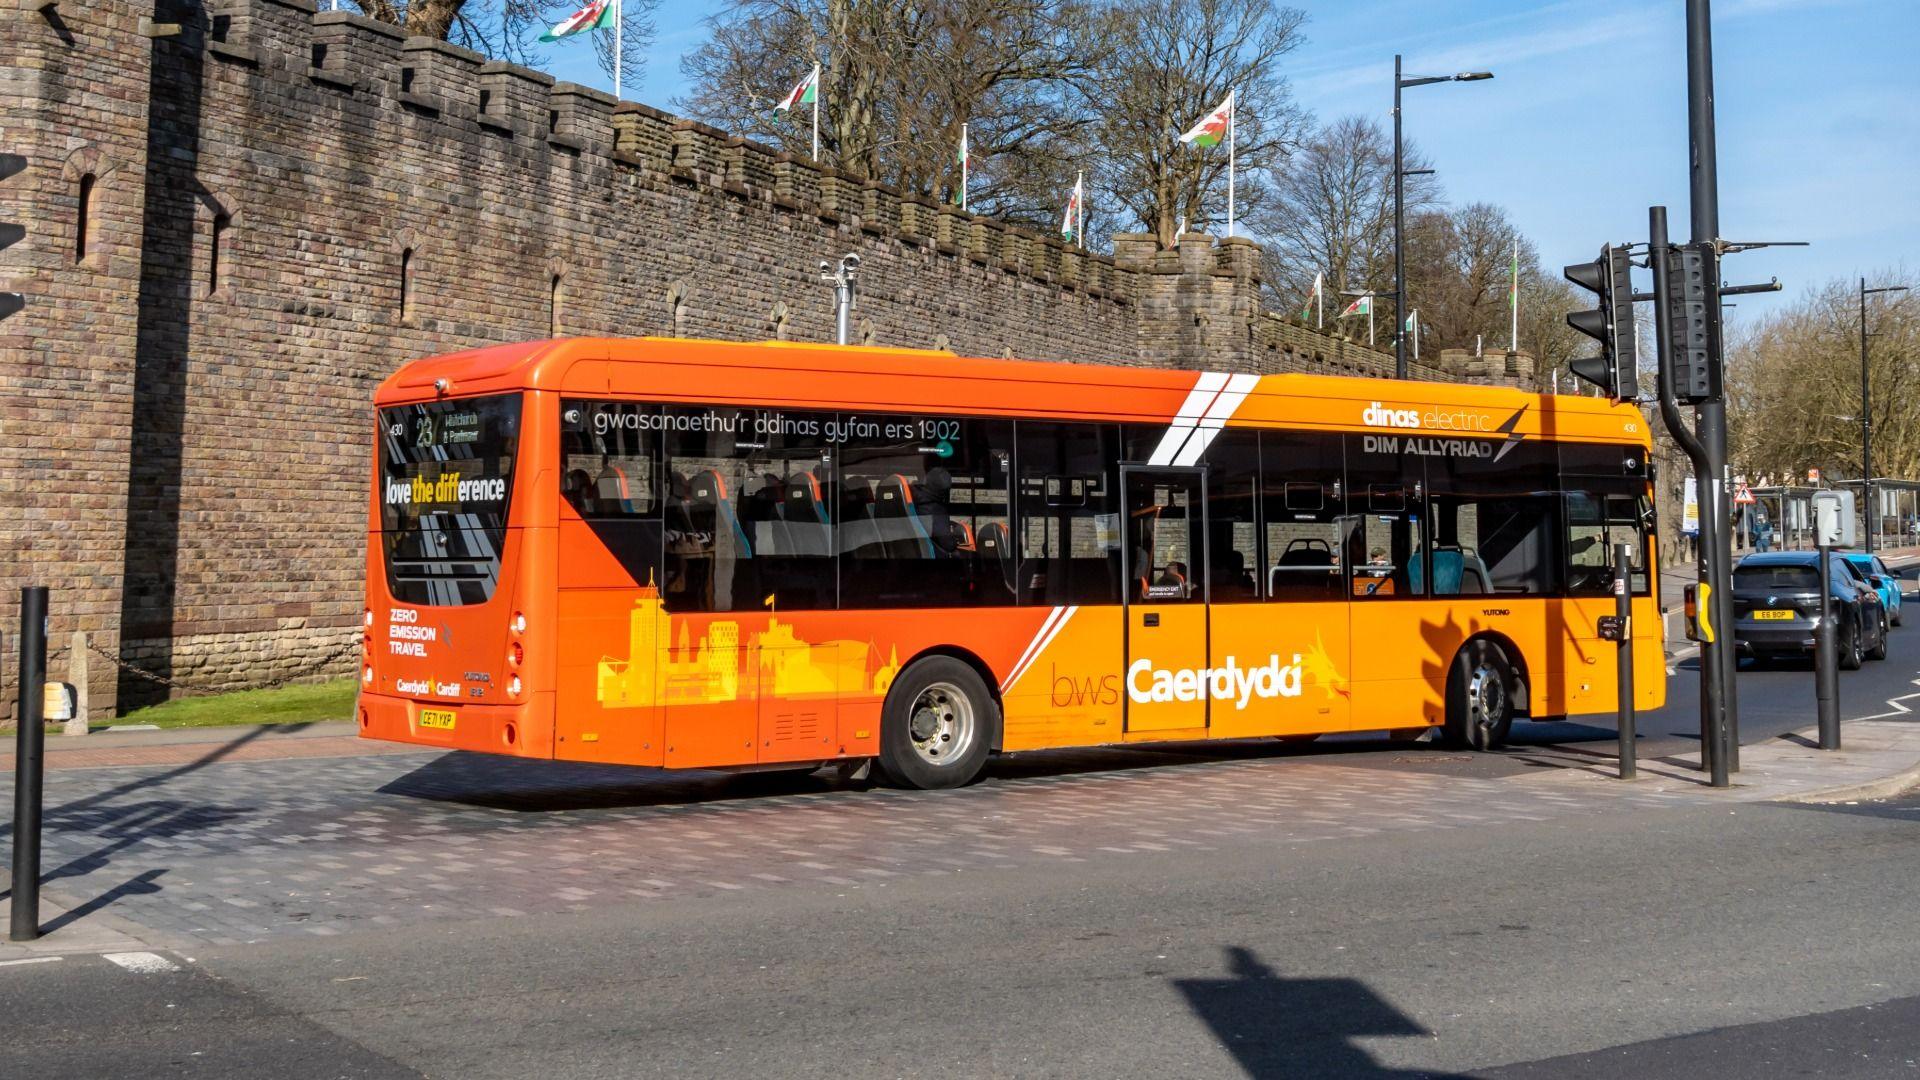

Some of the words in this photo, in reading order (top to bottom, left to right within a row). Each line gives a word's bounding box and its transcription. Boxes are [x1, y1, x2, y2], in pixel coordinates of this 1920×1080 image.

[594, 410, 748, 434] gwasanaethu'r
[755, 416, 819, 435] ddinas
[825, 418, 880, 443] gyfan
[886, 424, 914, 438] ers
[919, 419, 960, 440] 1902
[1363, 402, 1420, 428] dinas
[1423, 406, 1490, 432] electric
[390, 423, 402, 436] 430
[416, 416, 432, 447] 23
[1363, 436, 1398, 453] DIM
[1404, 437, 1492, 457] ALLYRIAD
[386, 476, 411, 503] love
[412, 474, 433, 503] the
[435, 472, 505, 502] difference
[390, 608, 417, 623] ZERO
[389, 625, 436, 641] EMISSION
[389, 641, 427, 656] TRAVEL
[397, 679, 429, 695] Caerdydd
[436, 682, 460, 696] Cardiff
[1051, 662, 1118, 708] bws
[1126, 654, 1301, 710] Caerdydd
[423, 711, 438, 725] CE71
[439, 713, 452, 726] YXP
